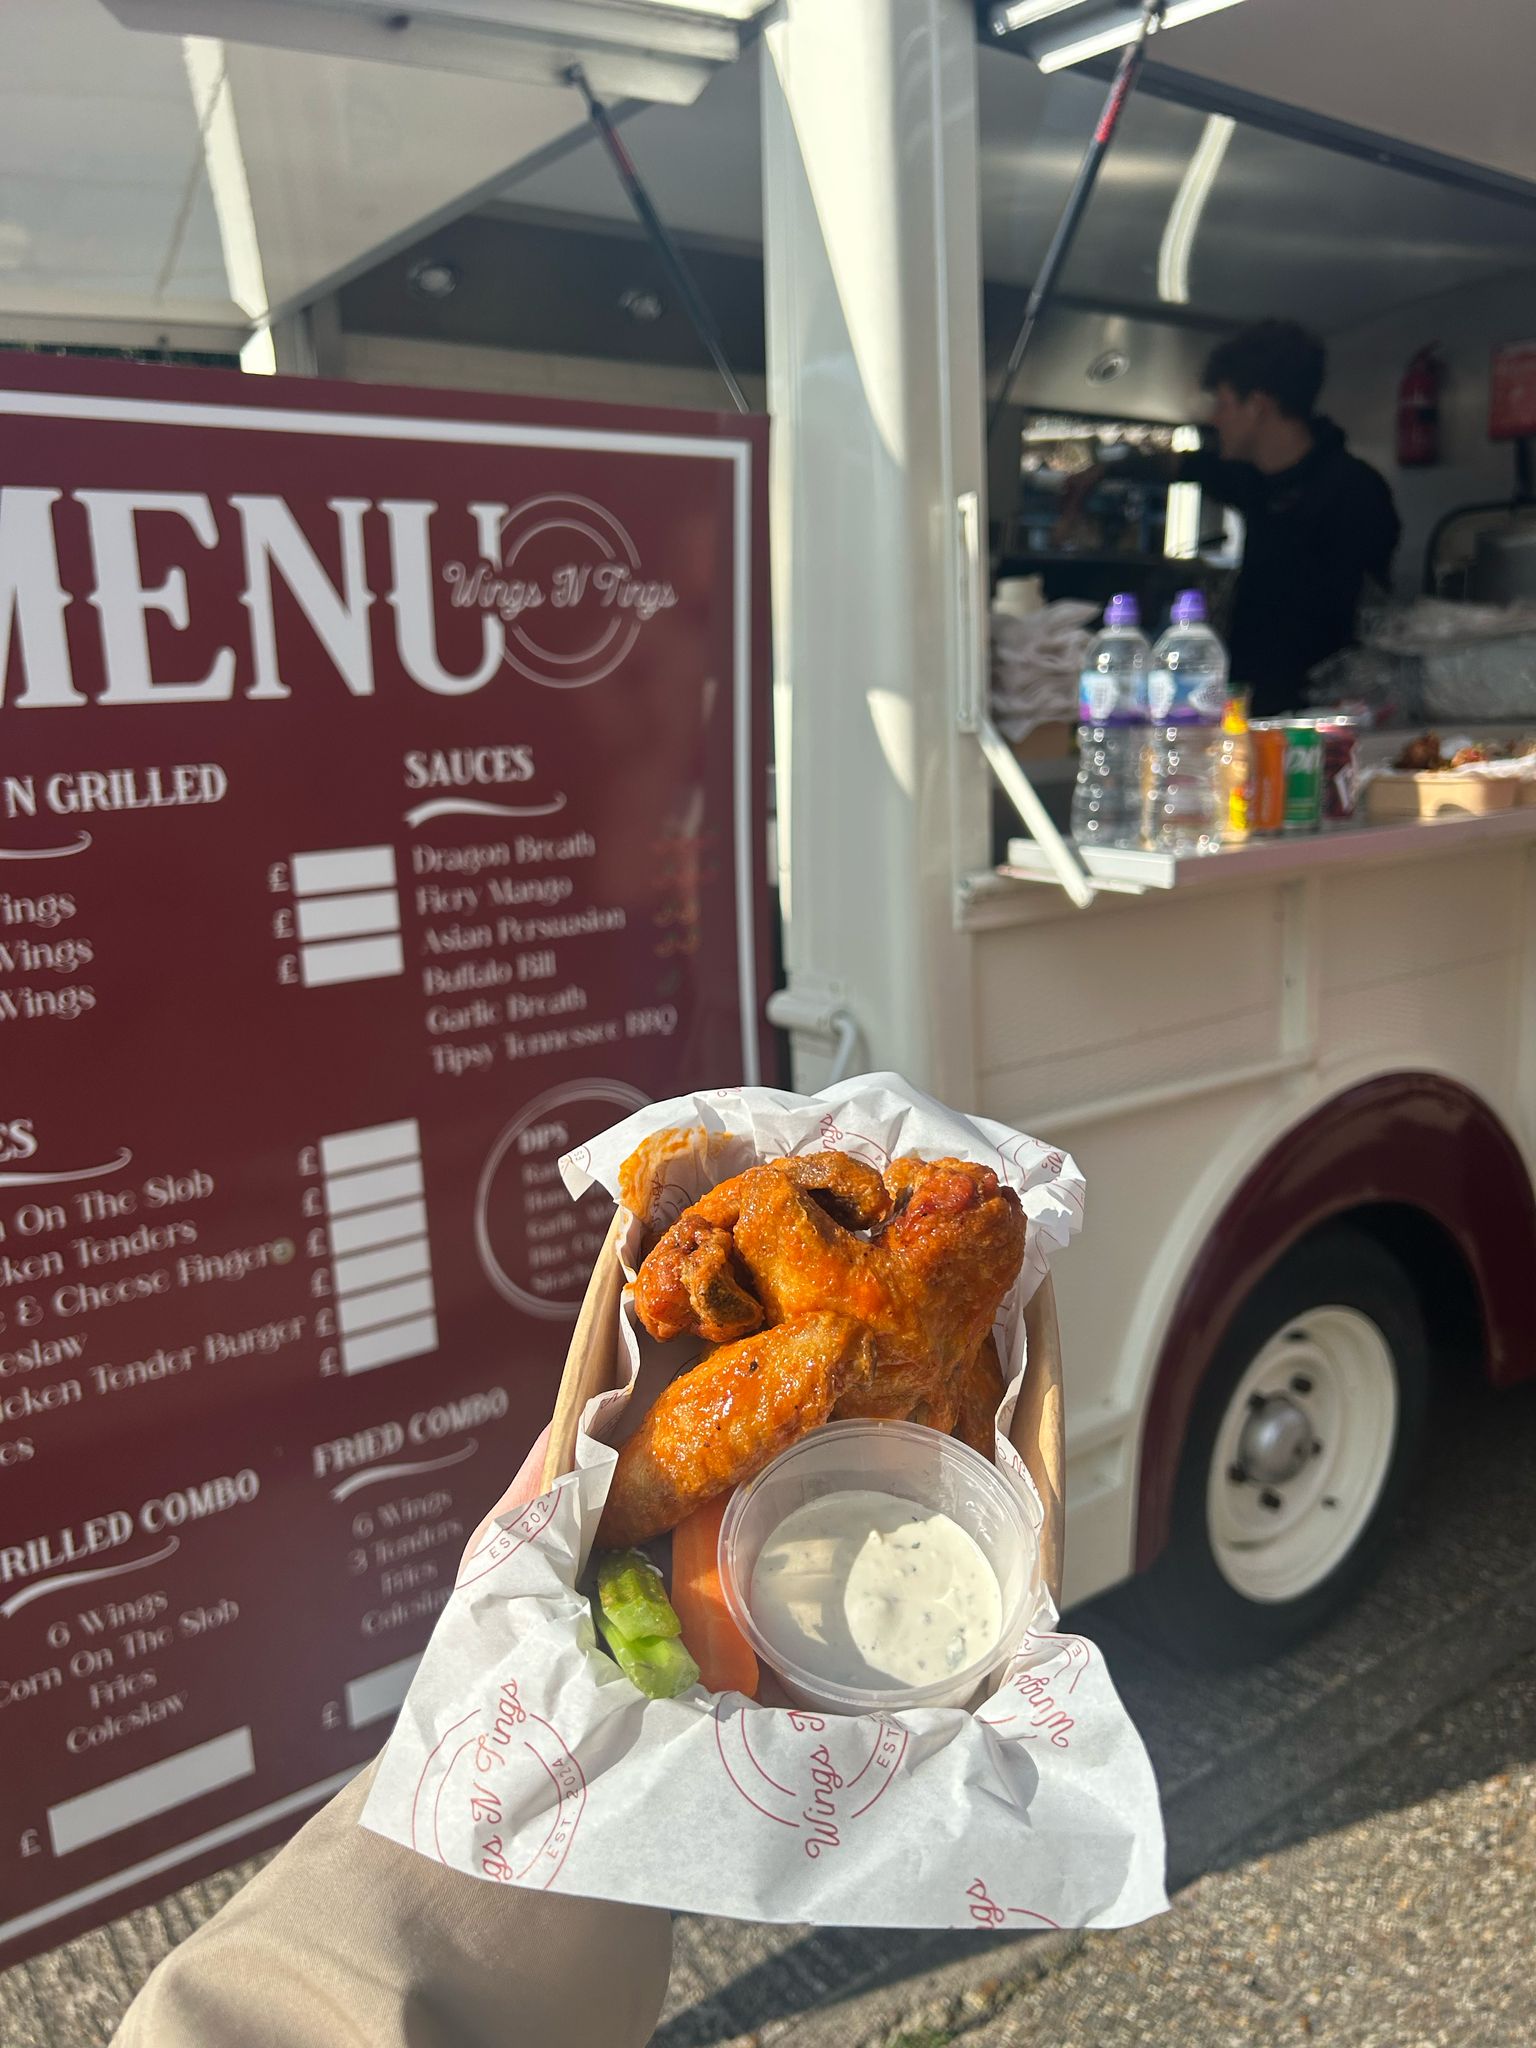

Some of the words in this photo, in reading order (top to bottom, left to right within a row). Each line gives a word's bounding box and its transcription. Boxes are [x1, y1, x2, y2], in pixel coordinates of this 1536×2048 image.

[442, 560, 546, 621] Wings
[550, 562, 593, 608] N
[592, 561, 679, 621] Tings
[4, 775, 37, 817] N
[46, 763, 228, 814] GRILLED
[404, 745, 536, 788] SAUCES
[267, 862, 290, 893] £
[411, 842, 511, 876] Dragon
[514, 829, 596, 864] Breath
[0, 892, 77, 929] ings
[415, 883, 481, 916] Fiery
[487, 875, 574, 907] Mango
[272, 908, 294, 939] £
[422, 922, 493, 955] Asian
[496, 905, 627, 946] Persuasion
[277, 953, 299, 985] £
[422, 958, 513, 996] Buffalo
[515, 949, 558, 983] Bill
[425, 998, 500, 1035] Garlic
[506, 982, 588, 1023] Breath
[431, 1041, 494, 1077] Tipsy
[503, 1018, 623, 1060] Tennessee
[624, 1002, 679, 1038] BBQ
[15, 1204, 67, 1236] On
[73, 1190, 138, 1223] The
[71, 1219, 199, 1269] Tenders
[52, 1268, 172, 1318] Cheese
[176, 1238, 296, 1288] Finger
[88, 1345, 199, 1396] Tender
[203, 1315, 306, 1364] Burger
[312, 1421, 405, 1479] FRIED
[408, 1386, 510, 1445] COMBO
[139, 1468, 261, 1534] COMBO
[376, 1489, 453, 1529] Wings
[47, 1620, 72, 1649] 6
[78, 1590, 169, 1636] Wings
[70, 1647, 114, 1679] On
[119, 1624, 174, 1660] The
[89, 1667, 158, 1711] Fries
[1014, 1674, 1075, 1748] Wings
[66, 1691, 189, 1754] Coleslaw
[475, 1677, 527, 1774] Tings
[552, 1757, 580, 1800] 2024
[803, 1743, 844, 1859] Wings
[19, 1827, 42, 1858] £
